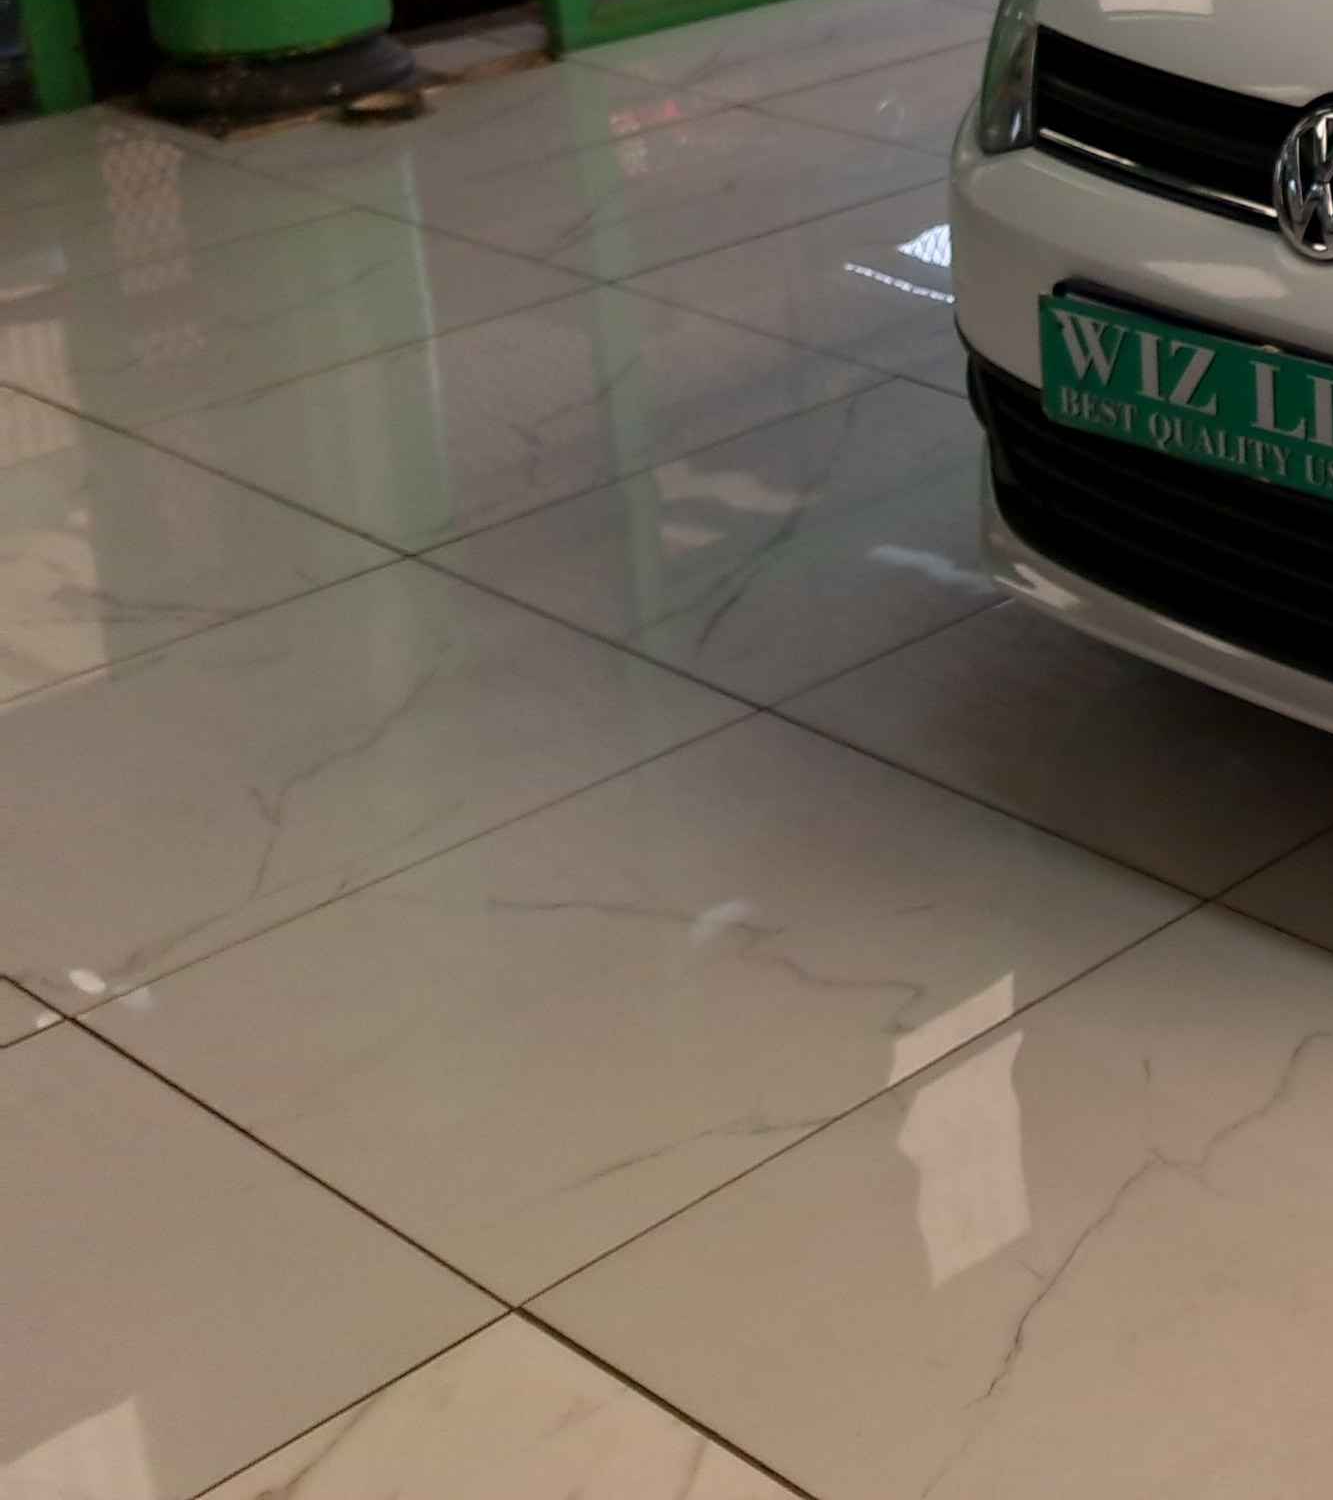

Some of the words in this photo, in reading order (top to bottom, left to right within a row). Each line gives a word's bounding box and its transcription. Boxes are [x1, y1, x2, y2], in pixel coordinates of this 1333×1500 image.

[1051, 308, 1220, 417] WIZ
[1061, 386, 1140, 432] BEST
[1148, 411, 1294, 476] QUALITY
